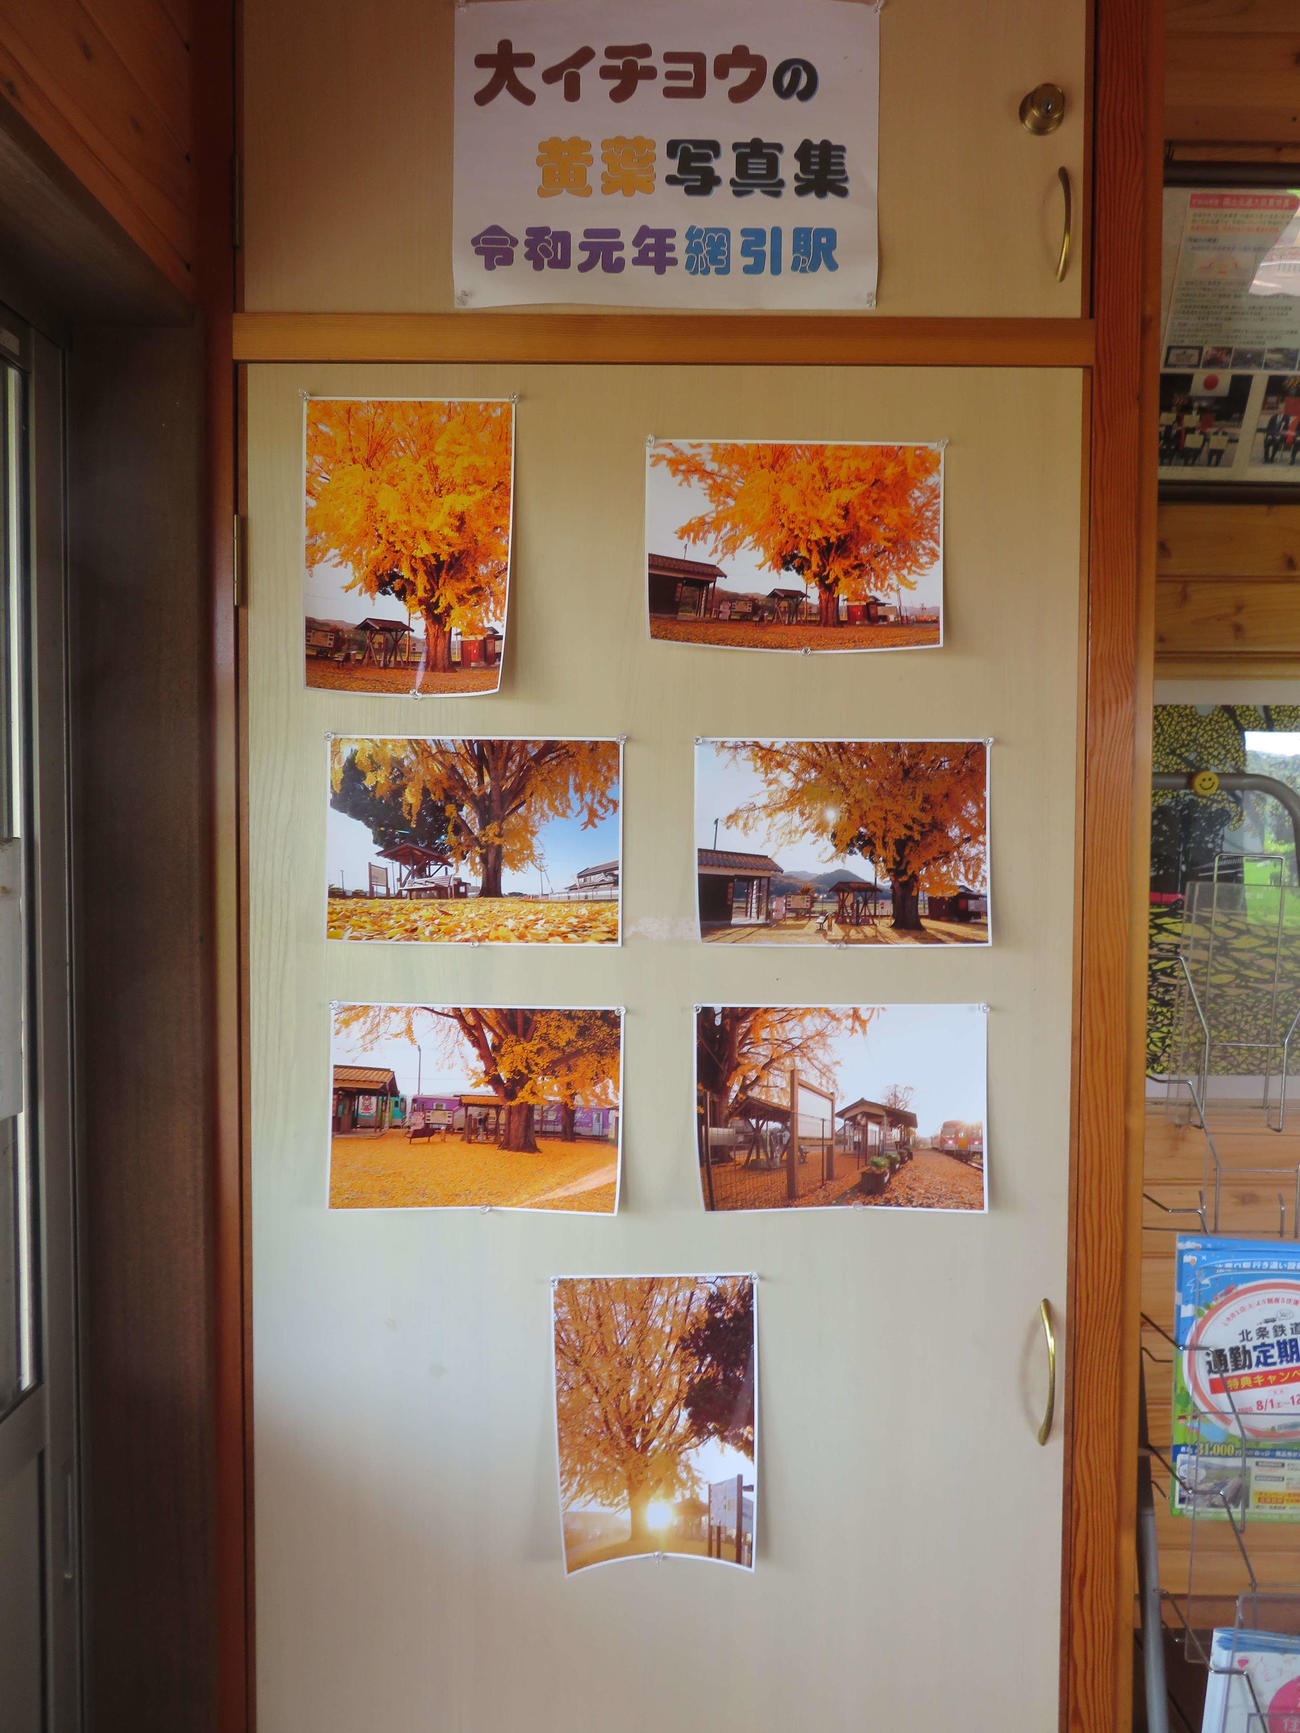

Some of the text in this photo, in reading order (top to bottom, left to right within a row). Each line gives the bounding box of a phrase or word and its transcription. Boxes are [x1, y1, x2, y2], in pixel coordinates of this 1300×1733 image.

[473, 38, 819, 106] 大イチョウの
[536, 136, 850, 199] 黄葉写真集
[470, 224, 839, 275] 令和元年網引駅
[1238, 1321, 1300, 1343] 北条鉄道
